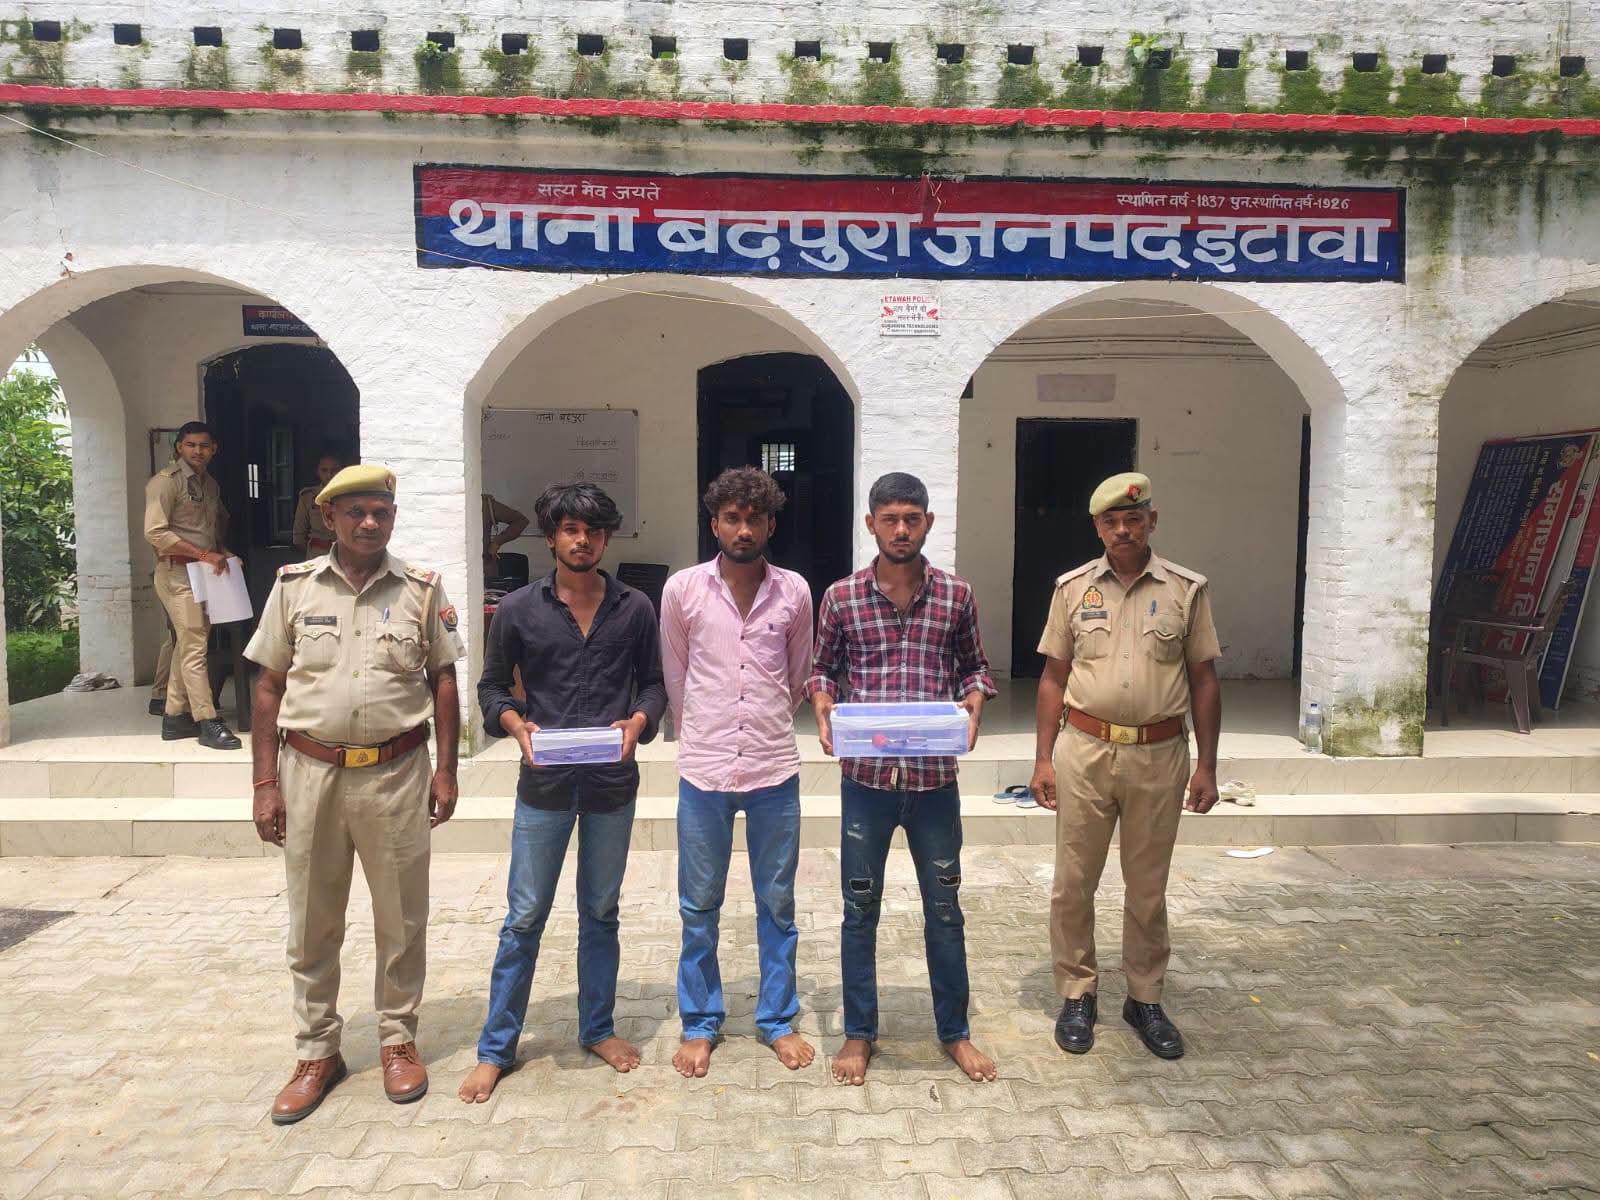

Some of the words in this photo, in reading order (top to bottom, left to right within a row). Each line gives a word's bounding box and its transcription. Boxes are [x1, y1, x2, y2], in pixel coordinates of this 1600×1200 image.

[538, 183, 577, 198] सत्य
[581, 181, 608, 199] मेव
[612, 182, 661, 200] जयते
[1169, 192, 1190, 207] वर्ष
[448, 199, 639, 252] थाना
[653, 208, 923, 272] बढ़पुरा
[923, 212, 1191, 269] जनपद
[1193, 216, 1391, 273] इटावा
